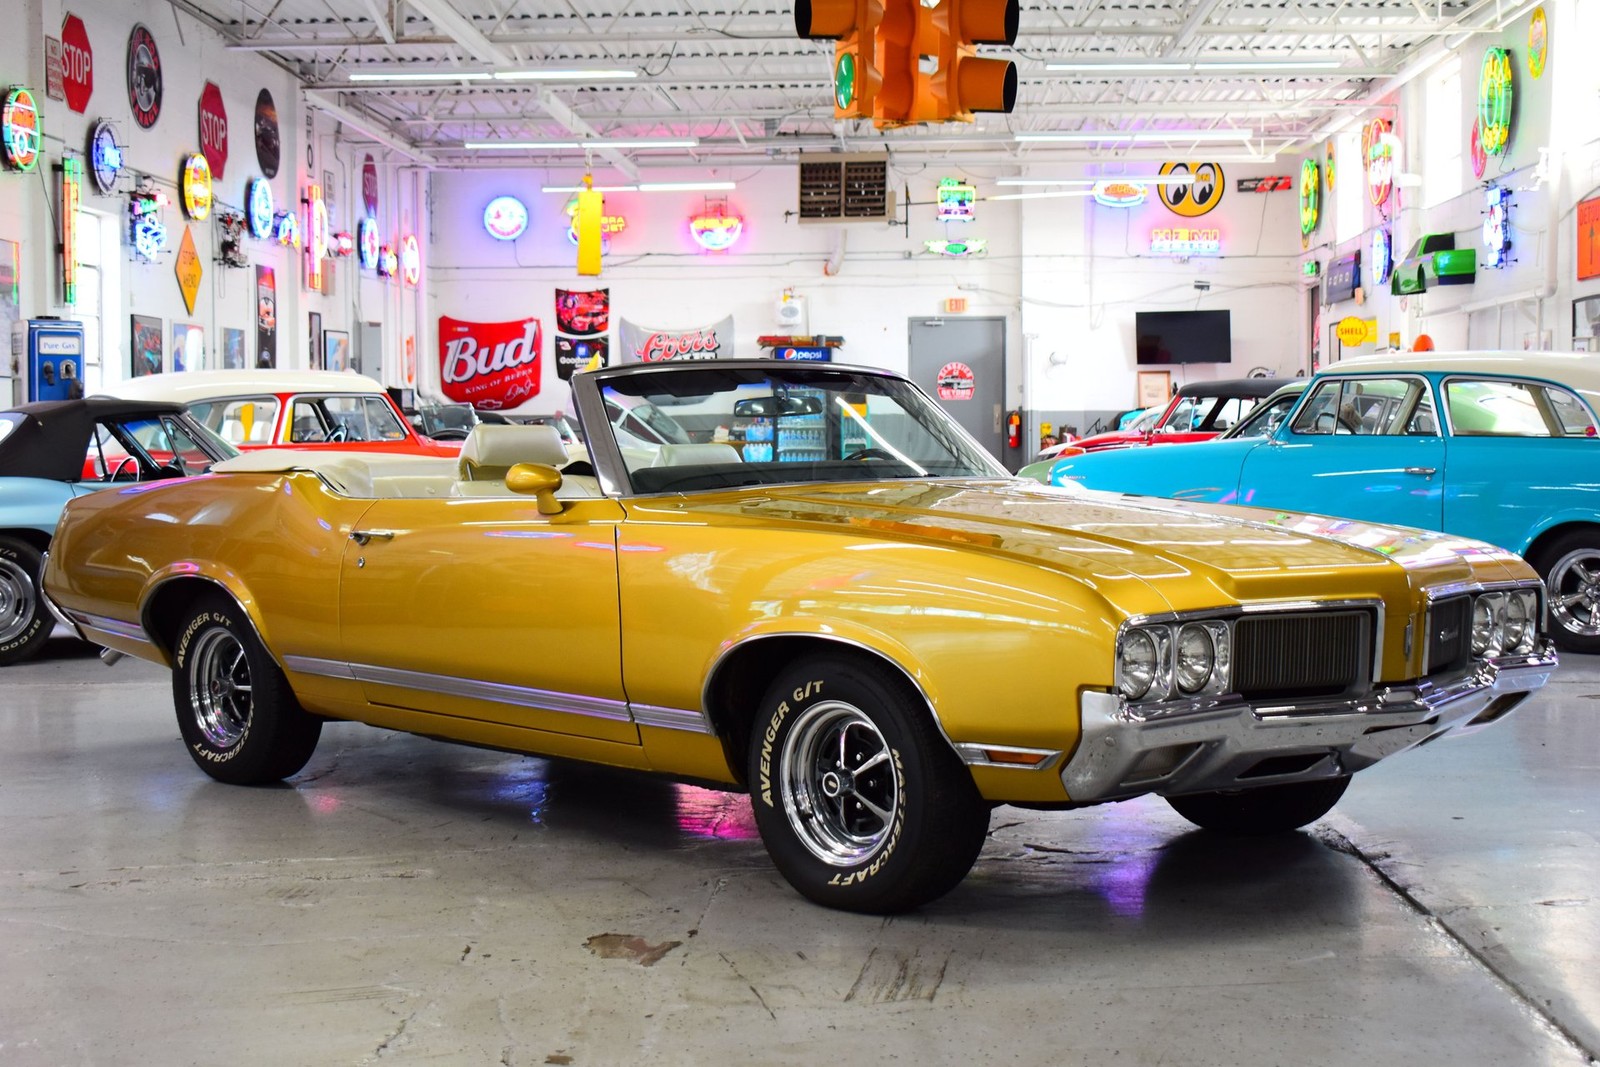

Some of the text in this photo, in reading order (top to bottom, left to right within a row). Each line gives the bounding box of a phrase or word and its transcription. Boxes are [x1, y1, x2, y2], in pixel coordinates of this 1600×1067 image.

[62, 42, 91, 85] STOP
[202, 109, 226, 152] STOP
[1152, 229, 1219, 241] HEMI
[949, 299, 965, 311] EXIT
[43, 338, 76, 350] Pure Gas
[635, 328, 719, 363] Coors
[1339, 327, 1363, 336] SHELL
[442, 320, 537, 384] Bud
[797, 350, 822, 361] pepsi
[465, 368, 533, 394] KING OF BEERS
[942, 389, 971, 398] BEYOND
[177, 611, 232, 669] AVENGER G/T
[760, 680, 824, 808] AVENGER G/T
[827, 748, 906, 886] MASTERCRAFT
